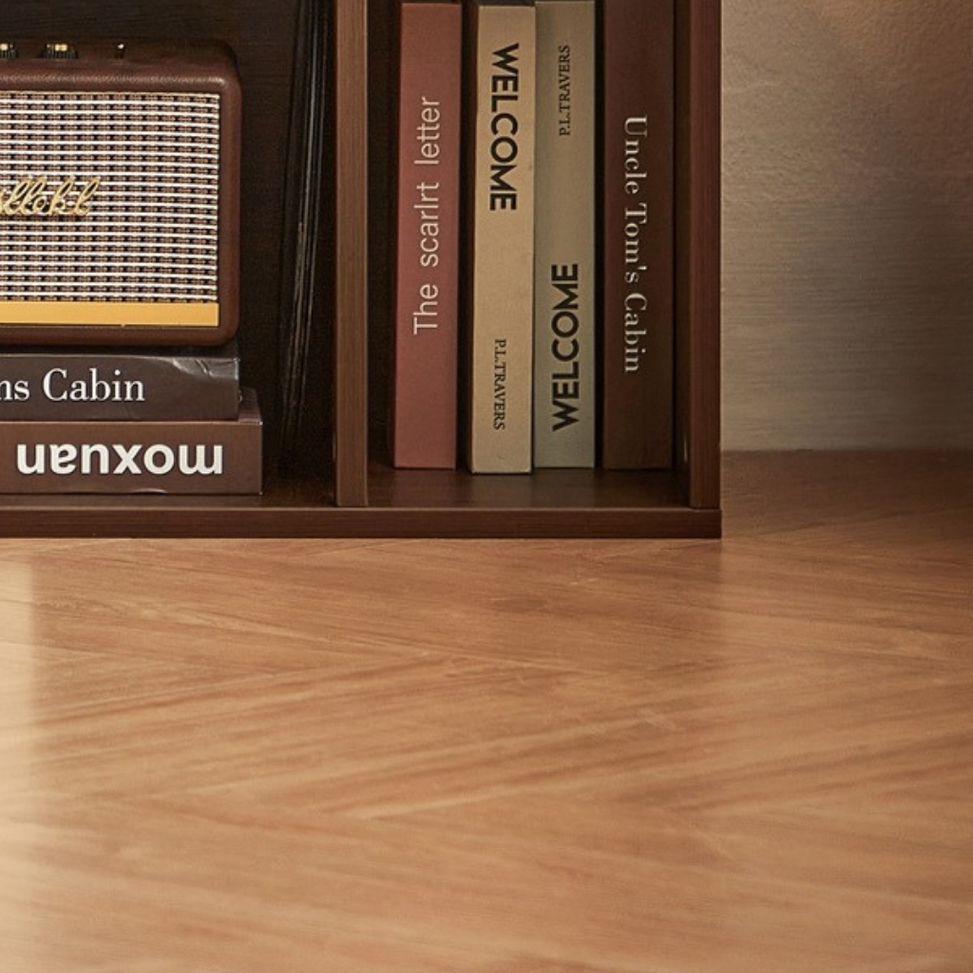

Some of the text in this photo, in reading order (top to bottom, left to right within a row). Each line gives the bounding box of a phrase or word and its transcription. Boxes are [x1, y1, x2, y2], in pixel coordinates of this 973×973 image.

[490, 42, 519, 211] WELCOME
[558, 44, 571, 137] P.L.TRAVERS
[413, 96, 440, 335] The scarlrt letter
[624, 116, 648, 374] Uncle Tom's Cabin
[42, 367, 146, 402] Cabin
[493, 338, 507, 431] P.L.TRAVERS
[551, 263, 580, 432] WELCOME
[16, 443, 225, 475] moxuan
